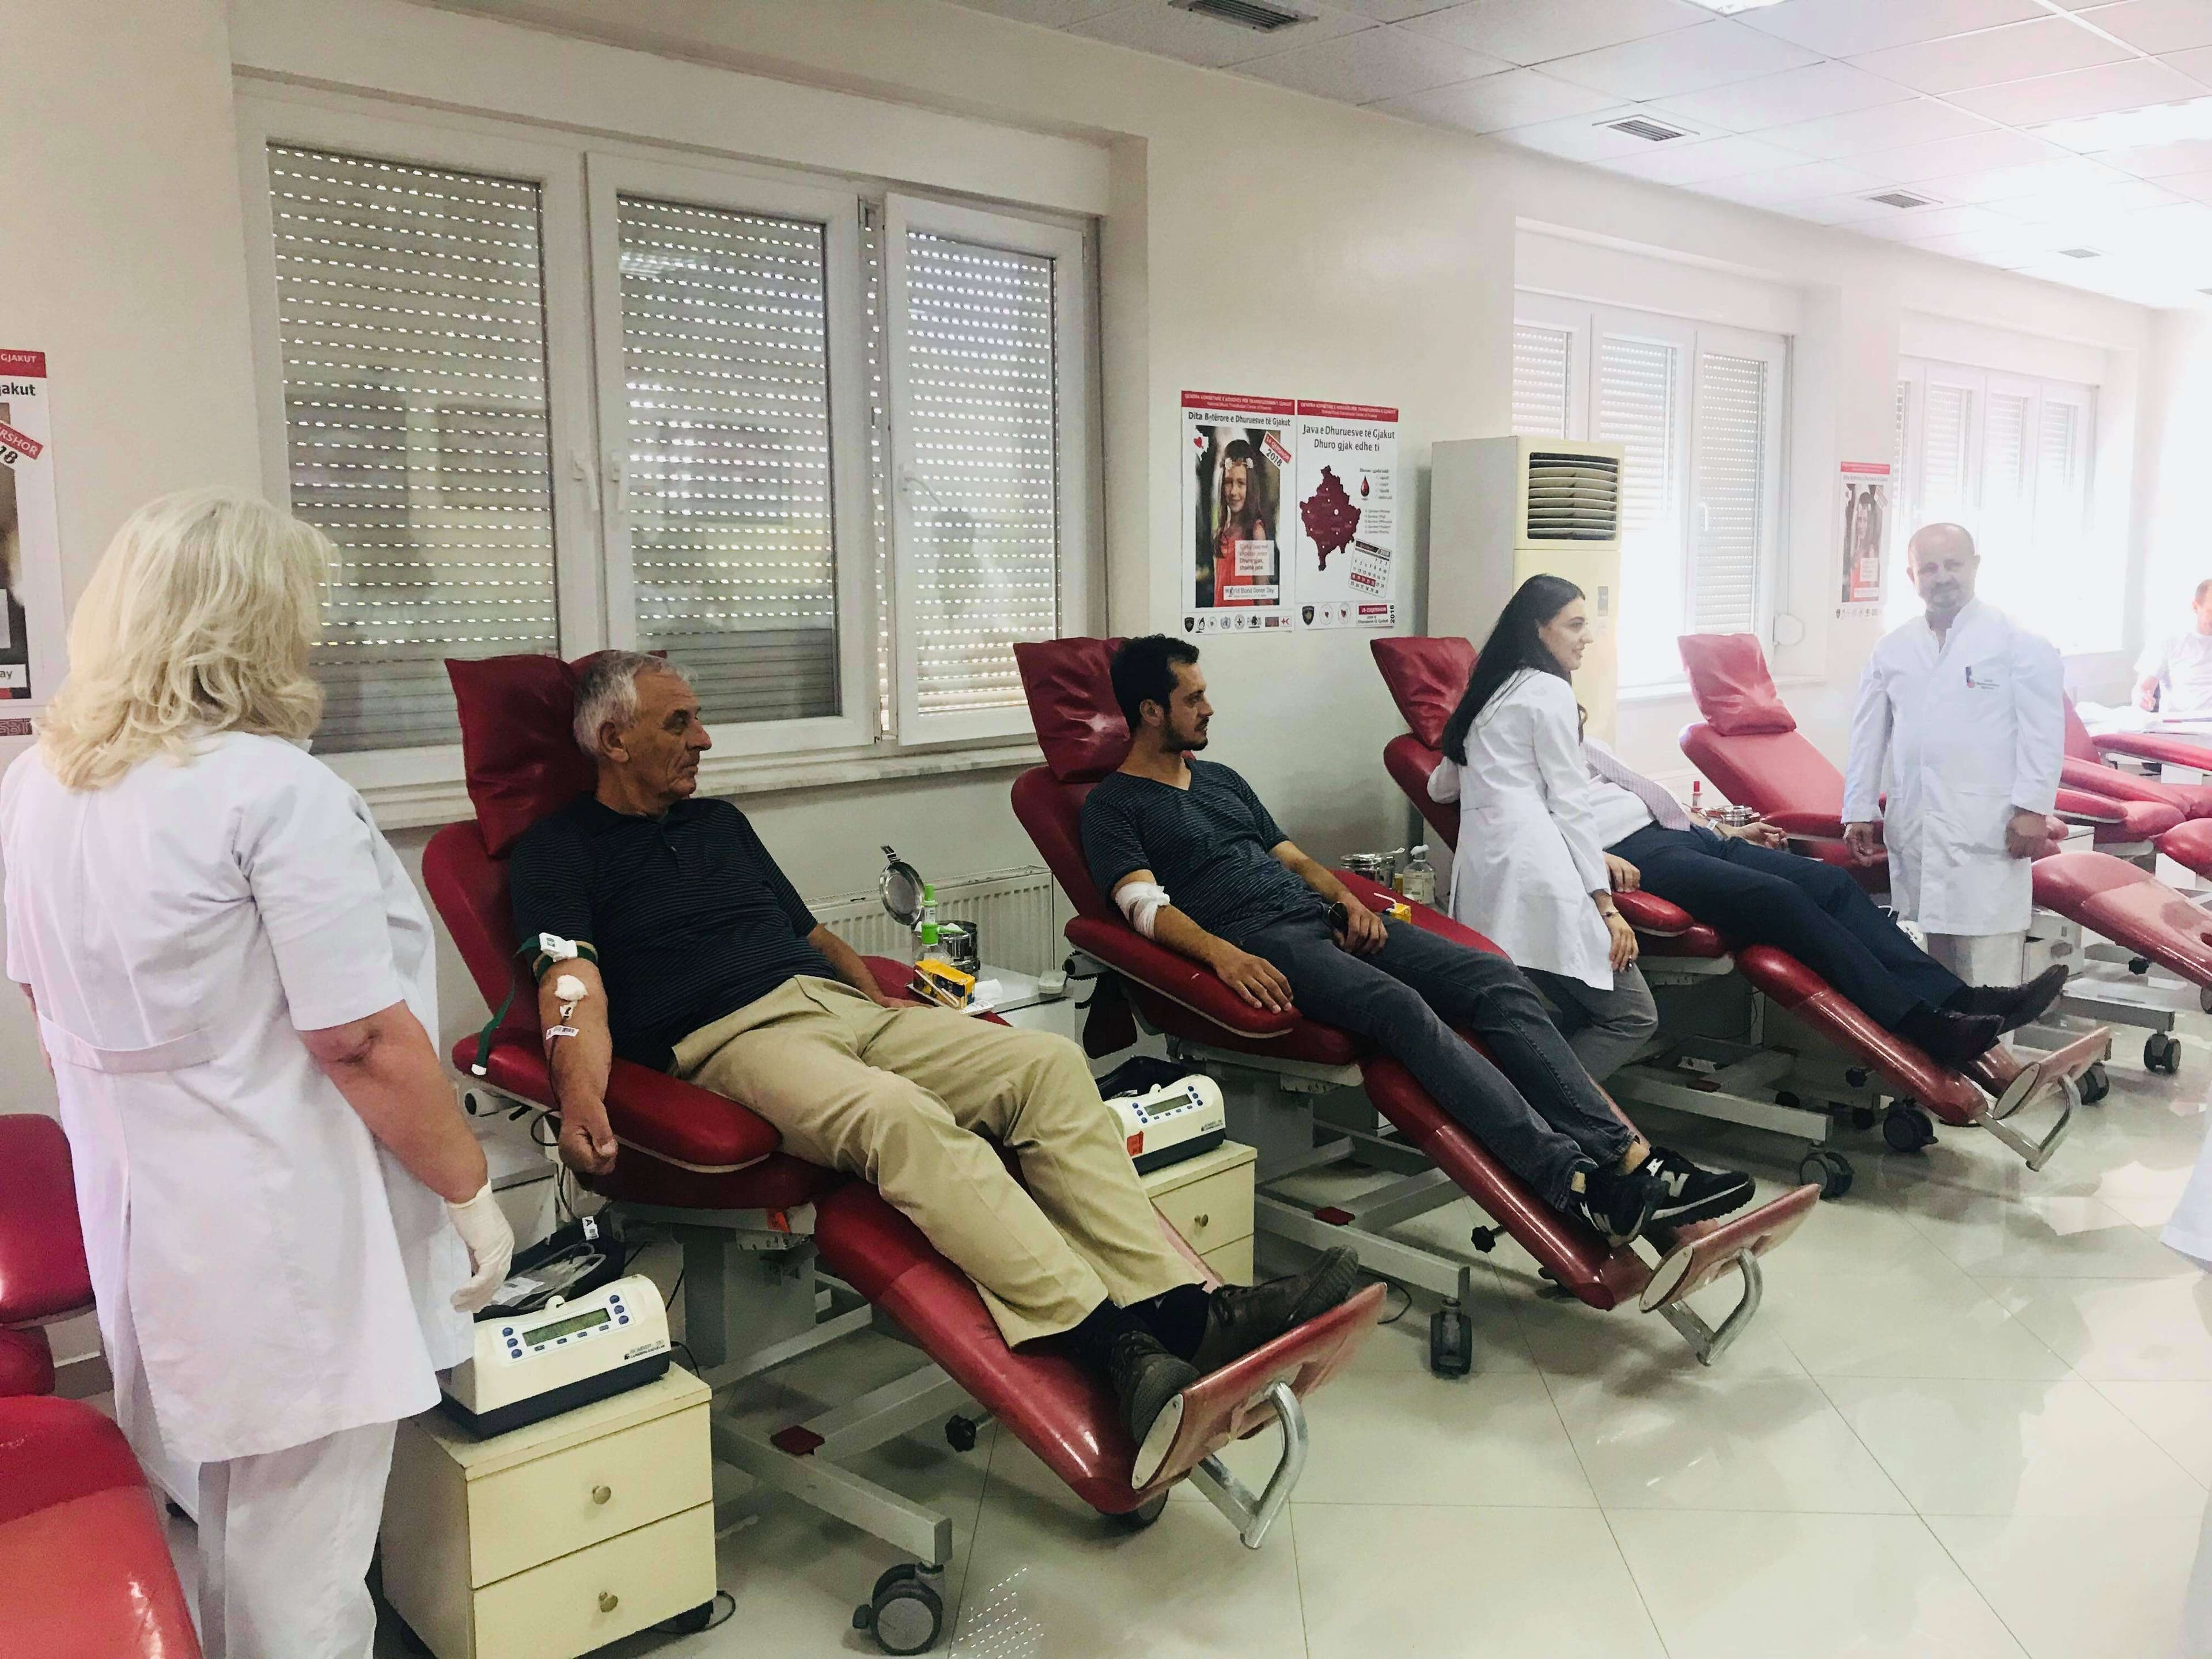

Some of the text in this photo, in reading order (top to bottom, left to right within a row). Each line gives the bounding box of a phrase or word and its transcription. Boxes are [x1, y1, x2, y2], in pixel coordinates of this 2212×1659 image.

[1, 353, 37, 363] GJAKUT
[0, 382, 36, 396] akut
[1188, 411, 1203, 421] Dita
[1272, 417, 1291, 427] Gjakut
[1302, 424, 1319, 435] Java
[1325, 425, 1363, 437] Dhuruesve
[1373, 429, 1395, 441] Gjakut
[0, 427, 38, 456] RSHOR
[1314, 438, 1380, 452] Dhuro gjak edhe ti
[1267, 448, 1282, 467] 2018
